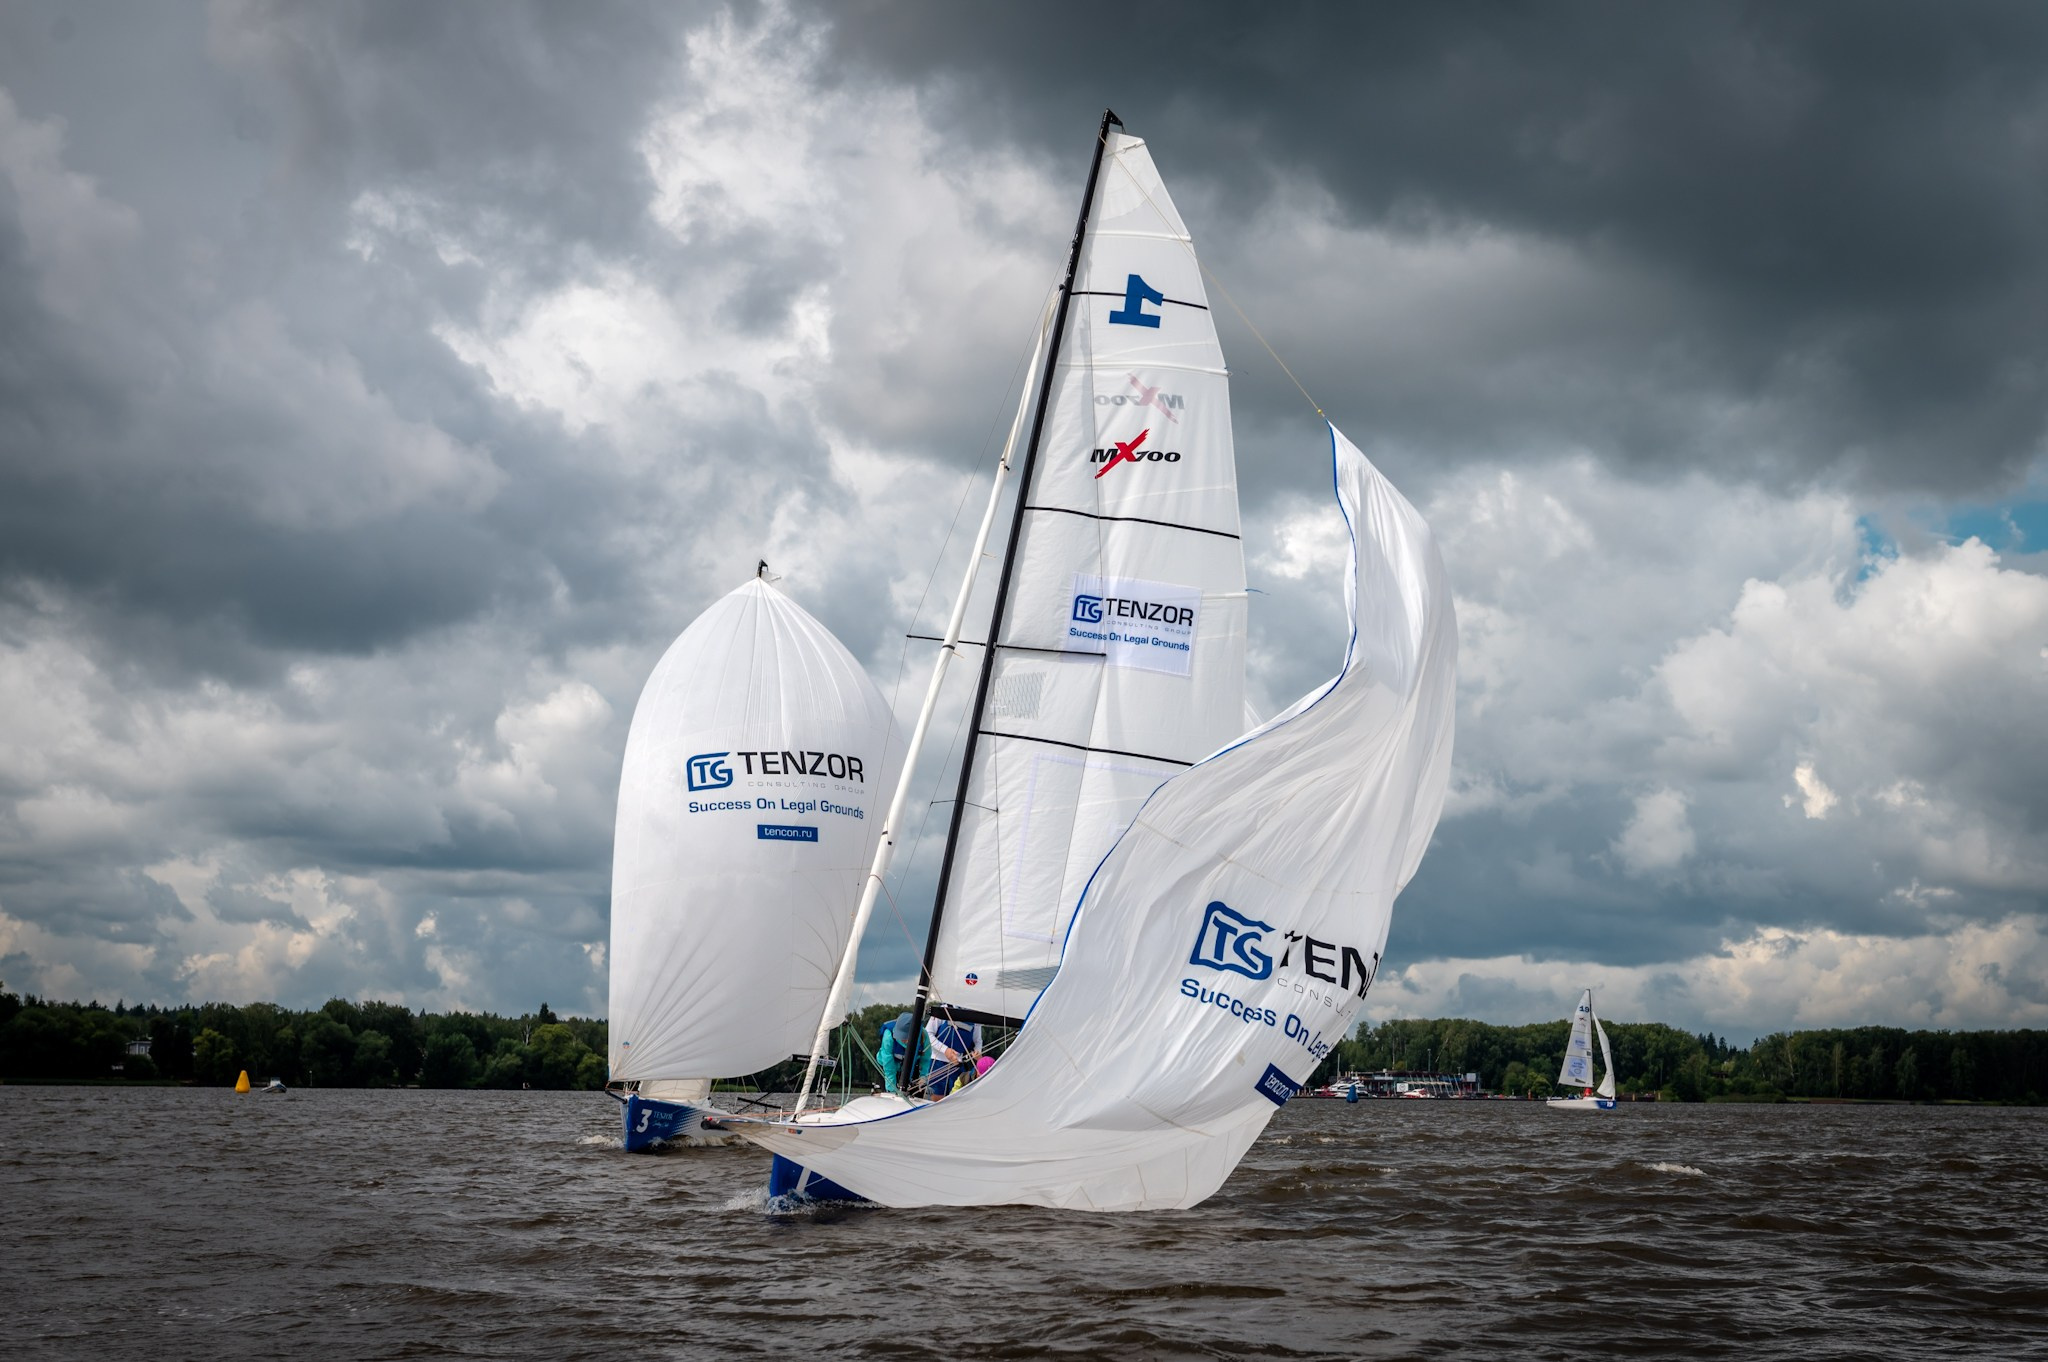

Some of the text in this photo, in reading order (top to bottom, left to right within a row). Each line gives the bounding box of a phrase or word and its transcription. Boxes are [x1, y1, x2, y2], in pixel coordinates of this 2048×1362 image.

[1090, 428, 1181, 479] MX700
[1106, 598, 1194, 627] TENZOR
[1069, 627, 1190, 651] Success On Legal Grounds
[1106, 620, 1192, 635] CONSULTING GROUP
[737, 750, 865, 783] TENZOR
[748, 781, 865, 795] CONSULTING GROUP
[689, 797, 864, 820] Success On Legal Grounds
[764, 827, 812, 839] tencon.ru
[1279, 930, 1382, 1001] TEN
[1180, 978, 1277, 1027] Success
[1284, 1013, 1310, 1047] On
[1277, 977, 1353, 1022] CONSU
[636, 1108, 653, 1133] 3
